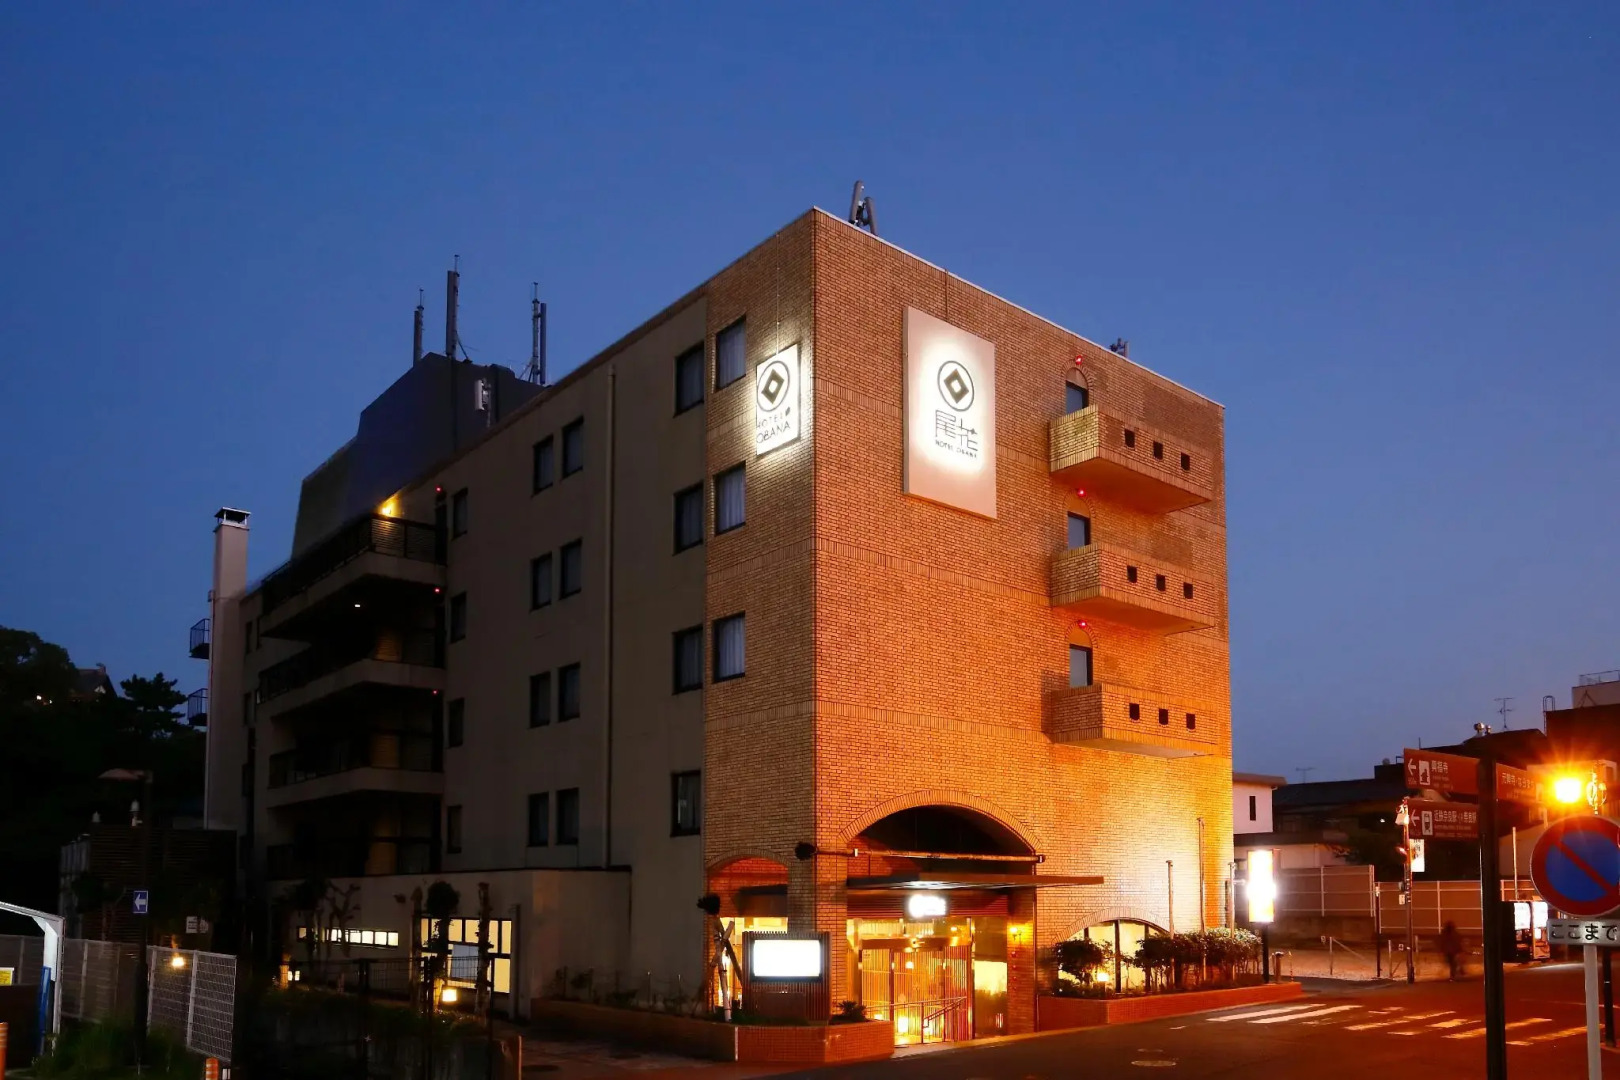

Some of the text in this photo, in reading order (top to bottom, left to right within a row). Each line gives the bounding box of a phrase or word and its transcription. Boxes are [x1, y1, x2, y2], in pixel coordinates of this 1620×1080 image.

[756, 420, 790, 444] OBANA
[935, 409, 978, 451] 尾花
[1551, 923, 1618, 941] ここまで
